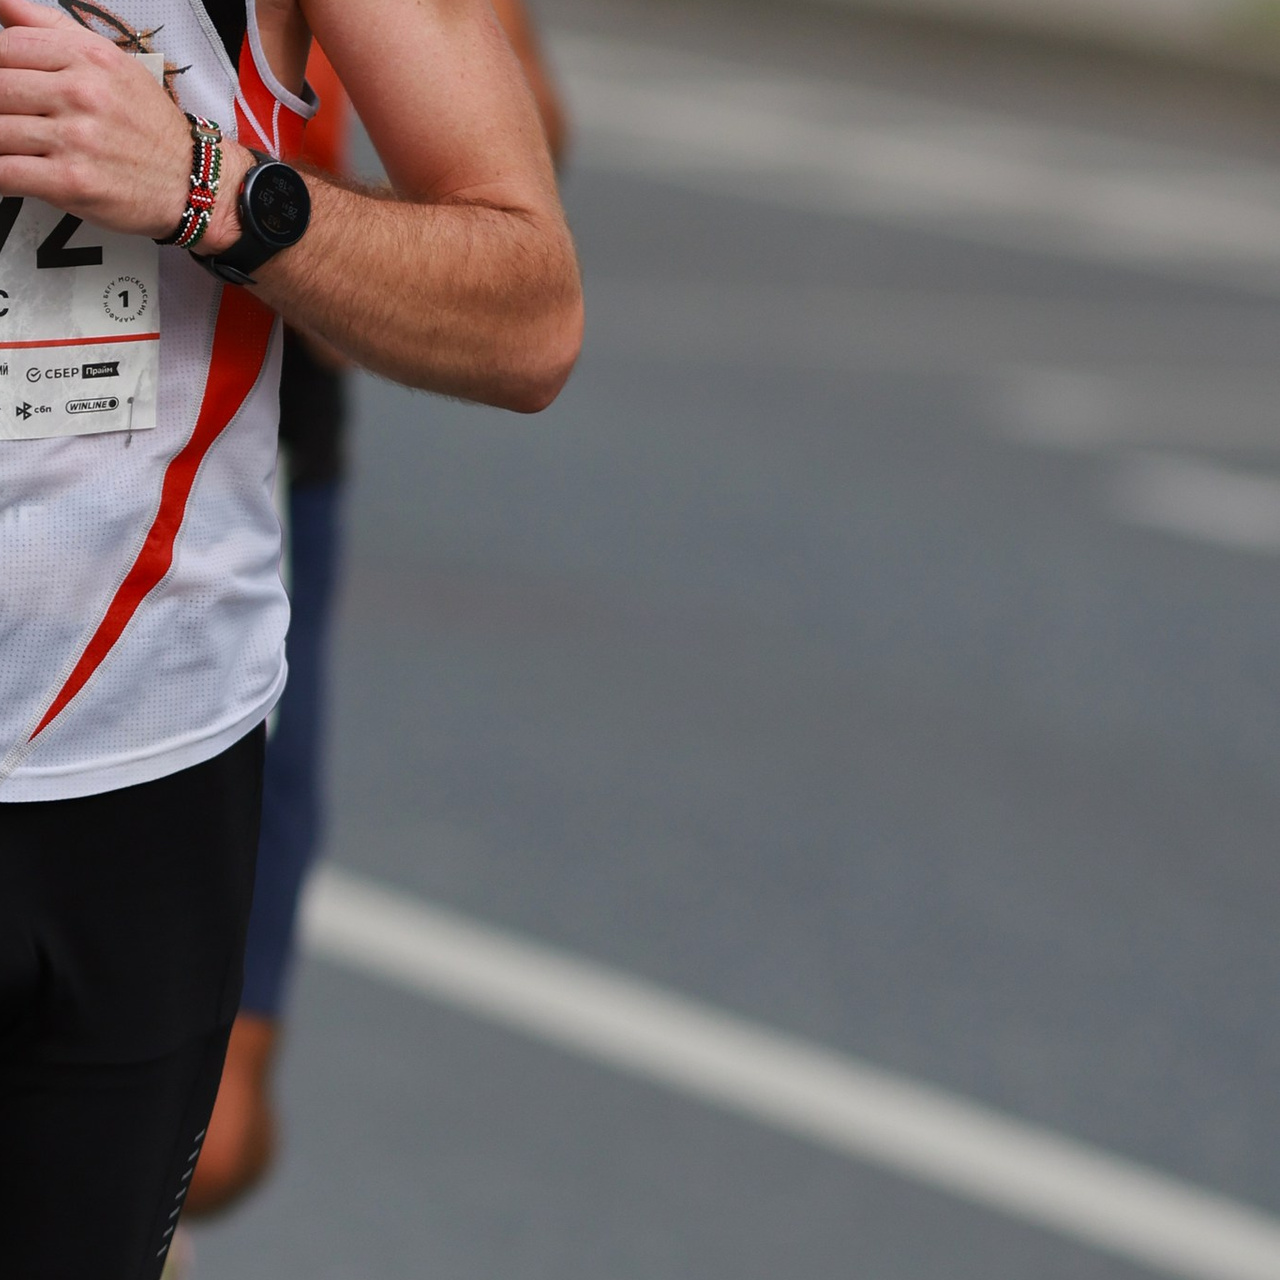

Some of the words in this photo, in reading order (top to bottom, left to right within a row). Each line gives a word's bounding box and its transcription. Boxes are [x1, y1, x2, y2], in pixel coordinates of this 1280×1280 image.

[118, 290, 129, 308] 1
[44, 367, 80, 380] СБЕР
[85, 365, 113, 376] Прайм
[69, 400, 108, 411] WINLINE
